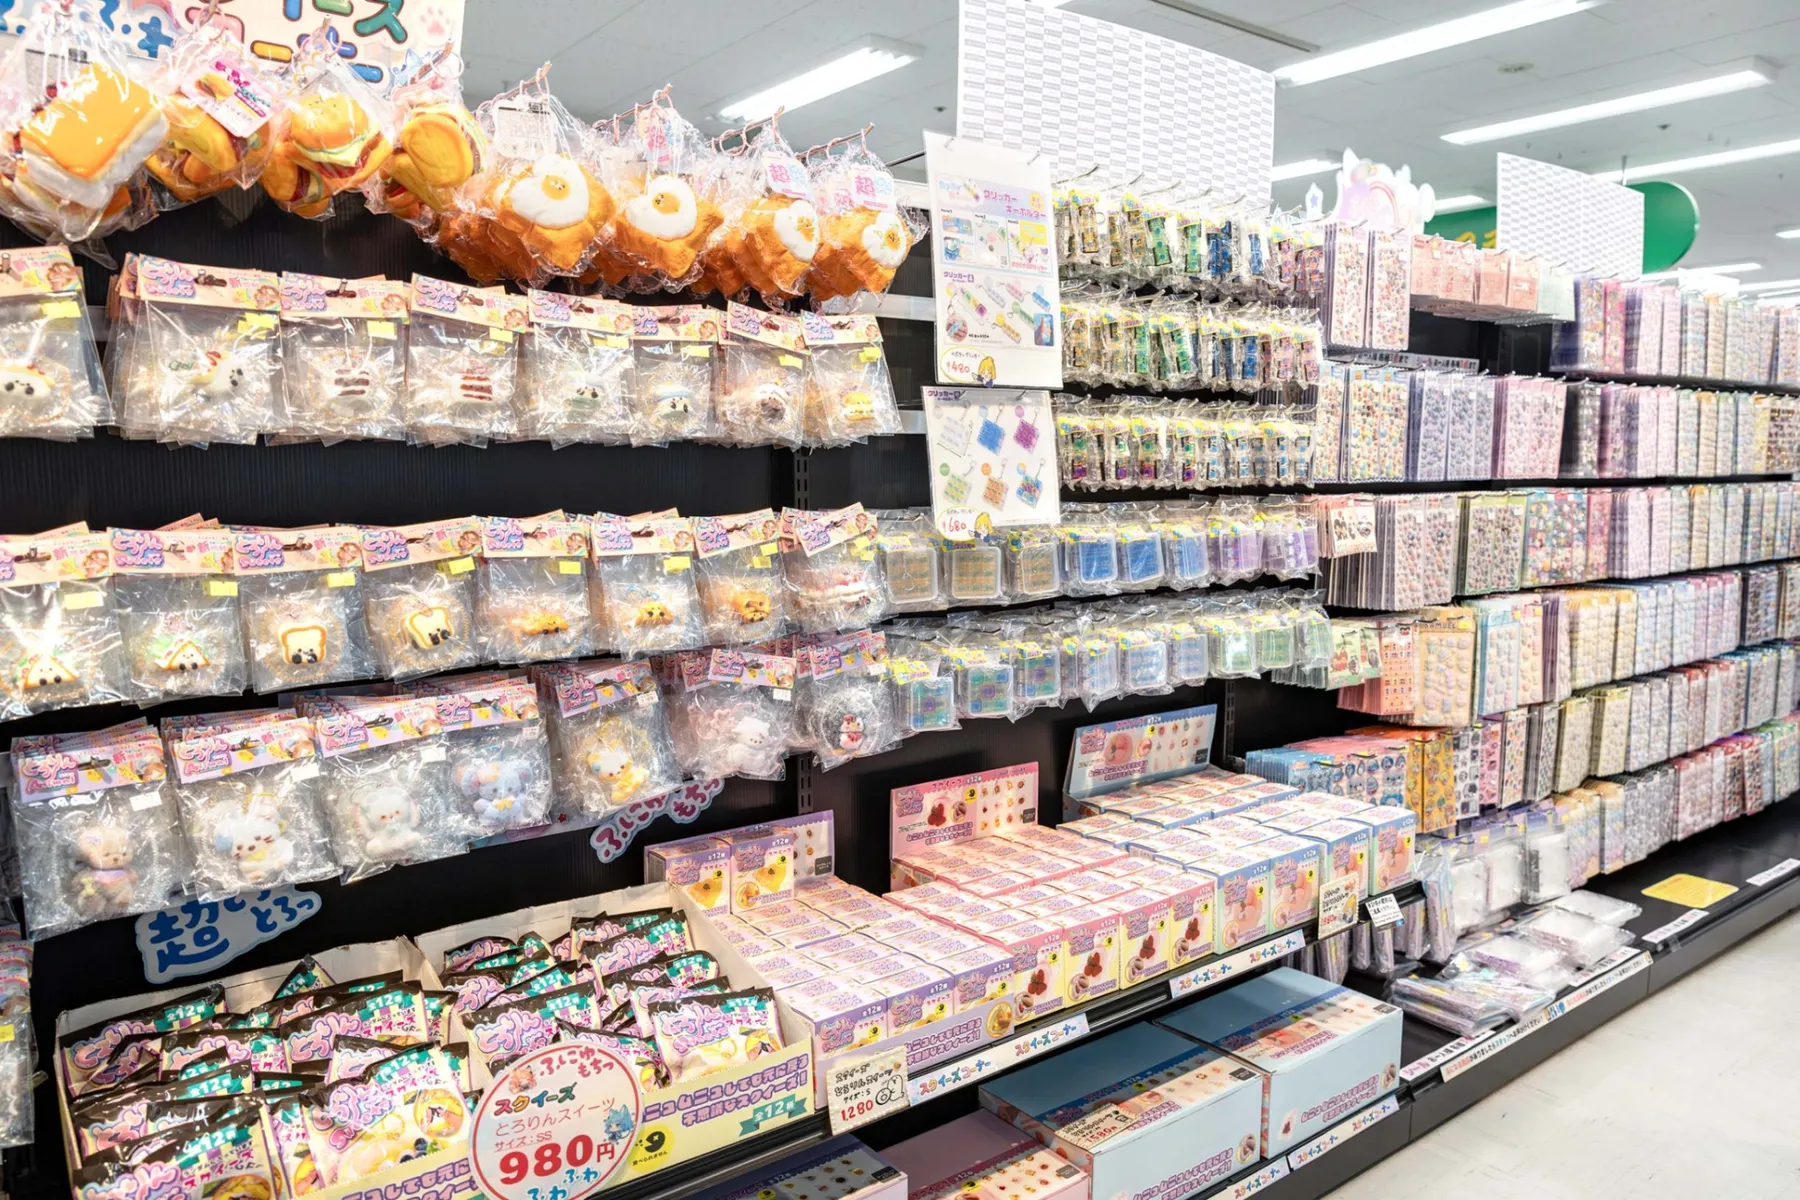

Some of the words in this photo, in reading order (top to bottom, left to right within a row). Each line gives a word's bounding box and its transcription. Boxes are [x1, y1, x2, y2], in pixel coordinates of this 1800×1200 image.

[983, 189, 1017, 202] クリッカー
[1179, 963, 1232, 990] スクイーズコーナー
[1015, 1024, 1077, 1056] スクイーズコーナー
[642, 1053, 809, 1123] ニュムニュしても元に戻る
[920, 1059, 991, 1096] スクイーズコーナー
[494, 1082, 577, 1117] スクイーズ
[496, 1098, 615, 1136] とろりんスイーツ
